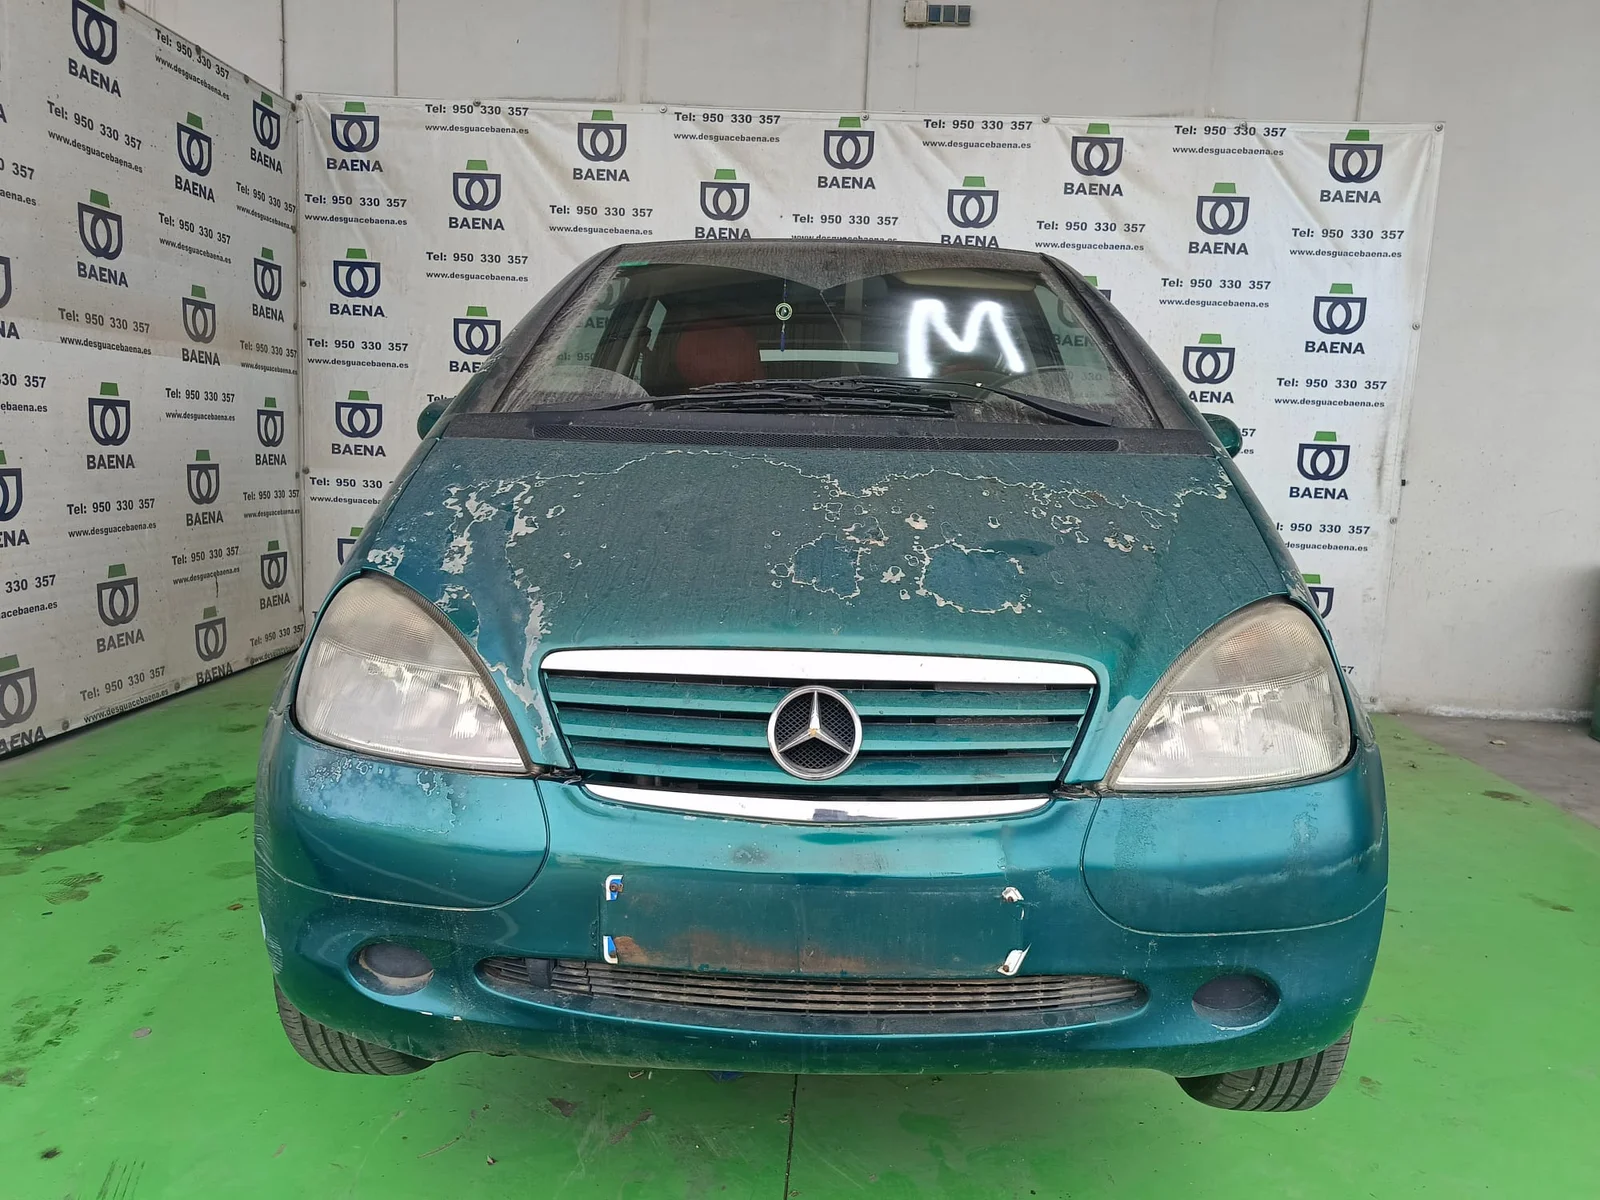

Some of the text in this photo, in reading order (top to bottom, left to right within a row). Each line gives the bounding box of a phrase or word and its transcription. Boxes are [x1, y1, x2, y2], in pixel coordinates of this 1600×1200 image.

[155, 28, 229, 80] Tel: 950 330 357
[69, 58, 121, 98] BAENA
[425, 104, 529, 116] Tel: 950 330 357
[675, 112, 780, 124] Tel: 950 330 357
[924, 119, 1032, 130] Tel: 950 330 357
[47, 100, 142, 150] Tel: 950 330 357
[425, 124, 529, 134] www.desguacebaena.es
[674, 132, 780, 143] www.desguacebaena.es
[1175, 126, 1286, 138] Tel: 950 330 357
[923, 140, 1031, 149] www.desguacebaena.es
[1173, 146, 1284, 157] www.desguacebaena.es
[250, 147, 283, 174] BAENA
[327, 158, 383, 172] BAENA
[12, 163, 35, 180] 357
[573, 168, 630, 181] BAENA
[174, 174, 215, 203] BAENA
[818, 176, 876, 189] BAENA
[1063, 183, 1123, 196] BAENA
[236, 182, 296, 214] Tel: 950 330 357
[305, 194, 406, 208] Tel: 950 330 357
[1320, 190, 1382, 203] BAENA
[550, 205, 653, 217] Tel: 950 330 357
[305, 214, 407, 225] www.desguacebaena.es
[449, 217, 504, 230] BAENA
[793, 214, 898, 225] Tel: 950 330 357
[159, 212, 231, 245] Tel: 950 330 357
[549, 225, 653, 235] www.desguacebaena.es
[695, 227, 751, 239] BAENA
[1037, 221, 1145, 233] Tel: 950 330 357
[1292, 228, 1404, 240] Tel: 950 330 357
[941, 235, 999, 248] BAENA
[1035, 241, 1144, 251] www.desguacebaena.es
[1189, 242, 1249, 255] BAENA
[1290, 248, 1402, 259] www.desguacebaena.es
[426, 252, 528, 265] Tel: 950 330 357
[77, 261, 128, 287] BAENA
[426, 272, 528, 282] www.desguacebaena.es
[1162, 278, 1271, 290] Tel: 950 330 357
[330, 303, 384, 317] BAENA
[1159, 298, 1269, 309] www.desguacebaena.es
[252, 303, 284, 322] BAENA
[58, 308, 150, 334] Tel: 950 330 357
[307, 338, 408, 352] Tel: 950 330 357
[907, 298, 1024, 379] M
[240, 340, 297, 358] Tel: 950 330 357
[1305, 341, 1365, 355] BAENA
[182, 348, 220, 366] BAENA
[308, 357, 409, 368] www.desguacebaena.es
[24, 376, 46, 389] 357
[1277, 378, 1387, 390] Tel: 950 330 357
[165, 388, 235, 403] Tel: 950 330 357
[1275, 397, 1385, 408] www.desguacebaena.es
[331, 444, 386, 457] BAENA
[86, 454, 135, 470] BAENA
[255, 454, 287, 466] BAENA
[310, 477, 329, 486] Tel:
[336, 479, 356, 487] 950
[362, 480, 382, 488] 330
[243, 489, 300, 501] Tel: 950 330 357
[1289, 487, 1349, 500] BAENA
[67, 498, 155, 515] Tel: 950 330 357
[186, 511, 224, 526] BAENA
[1290, 523, 1370, 535] 950 330 357
[172, 546, 239, 565] Tel: 950 330 357
[259, 593, 290, 610] BAENA
[96, 628, 145, 653] BAENA
[196, 662, 233, 685] BAENA
[80, 666, 165, 701] Tel: 950 330 357
